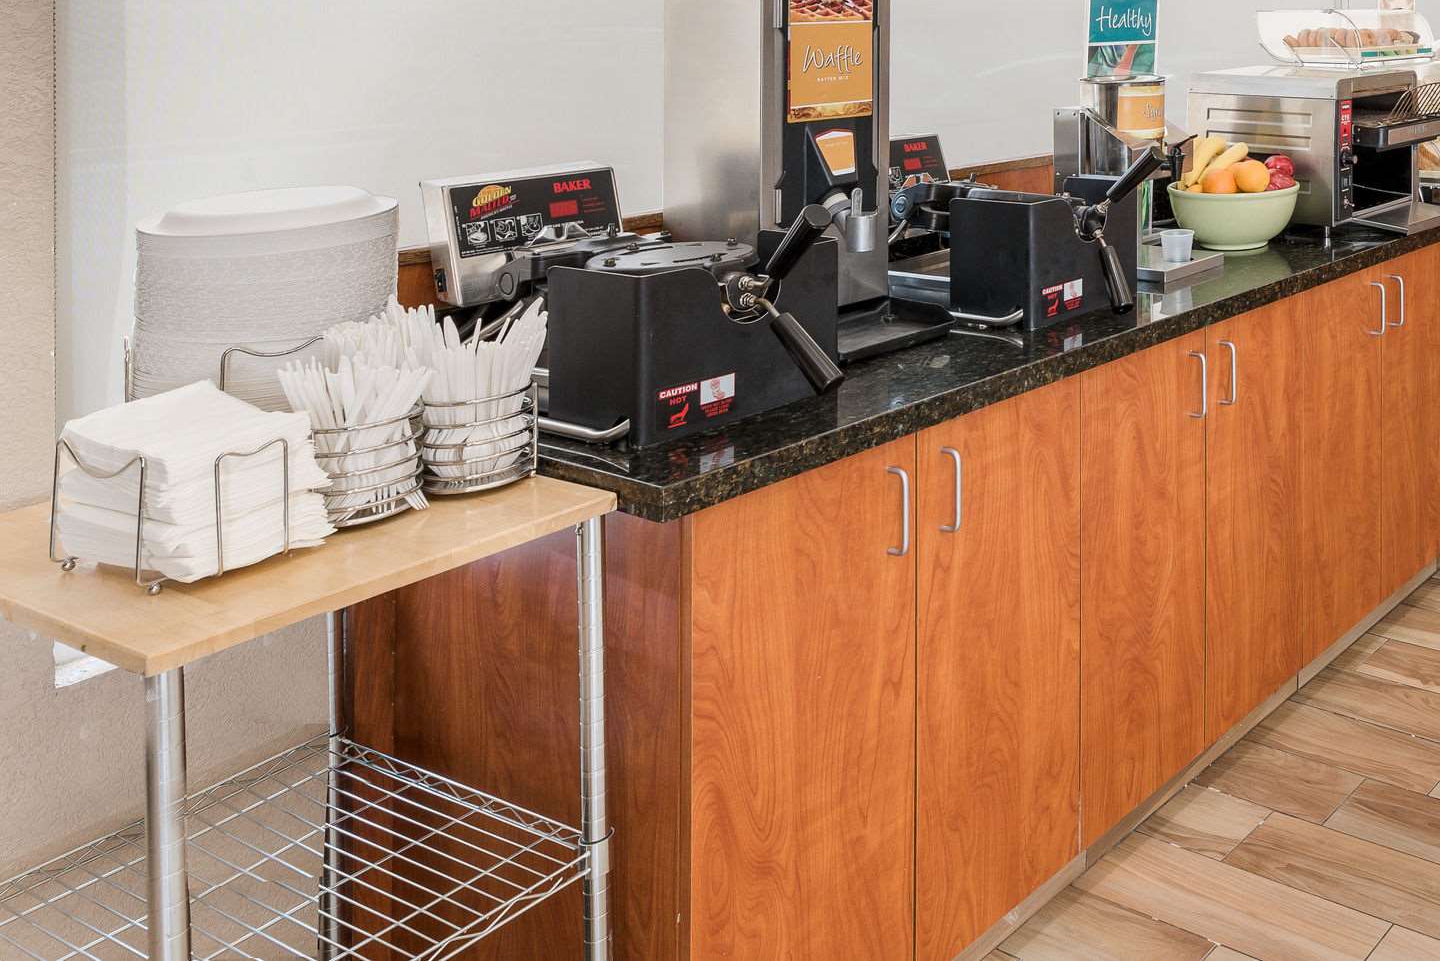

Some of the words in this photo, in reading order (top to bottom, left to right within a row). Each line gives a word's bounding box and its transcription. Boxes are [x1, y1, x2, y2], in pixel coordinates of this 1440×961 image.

[1096, 5, 1152, 36] Healthy
[802, 45, 864, 74] Waffle
[903, 142, 928, 153] BAKER
[553, 178, 592, 194] BAKER
[659, 383, 698, 399] CAUTION
[669, 396, 687, 406] HOT
